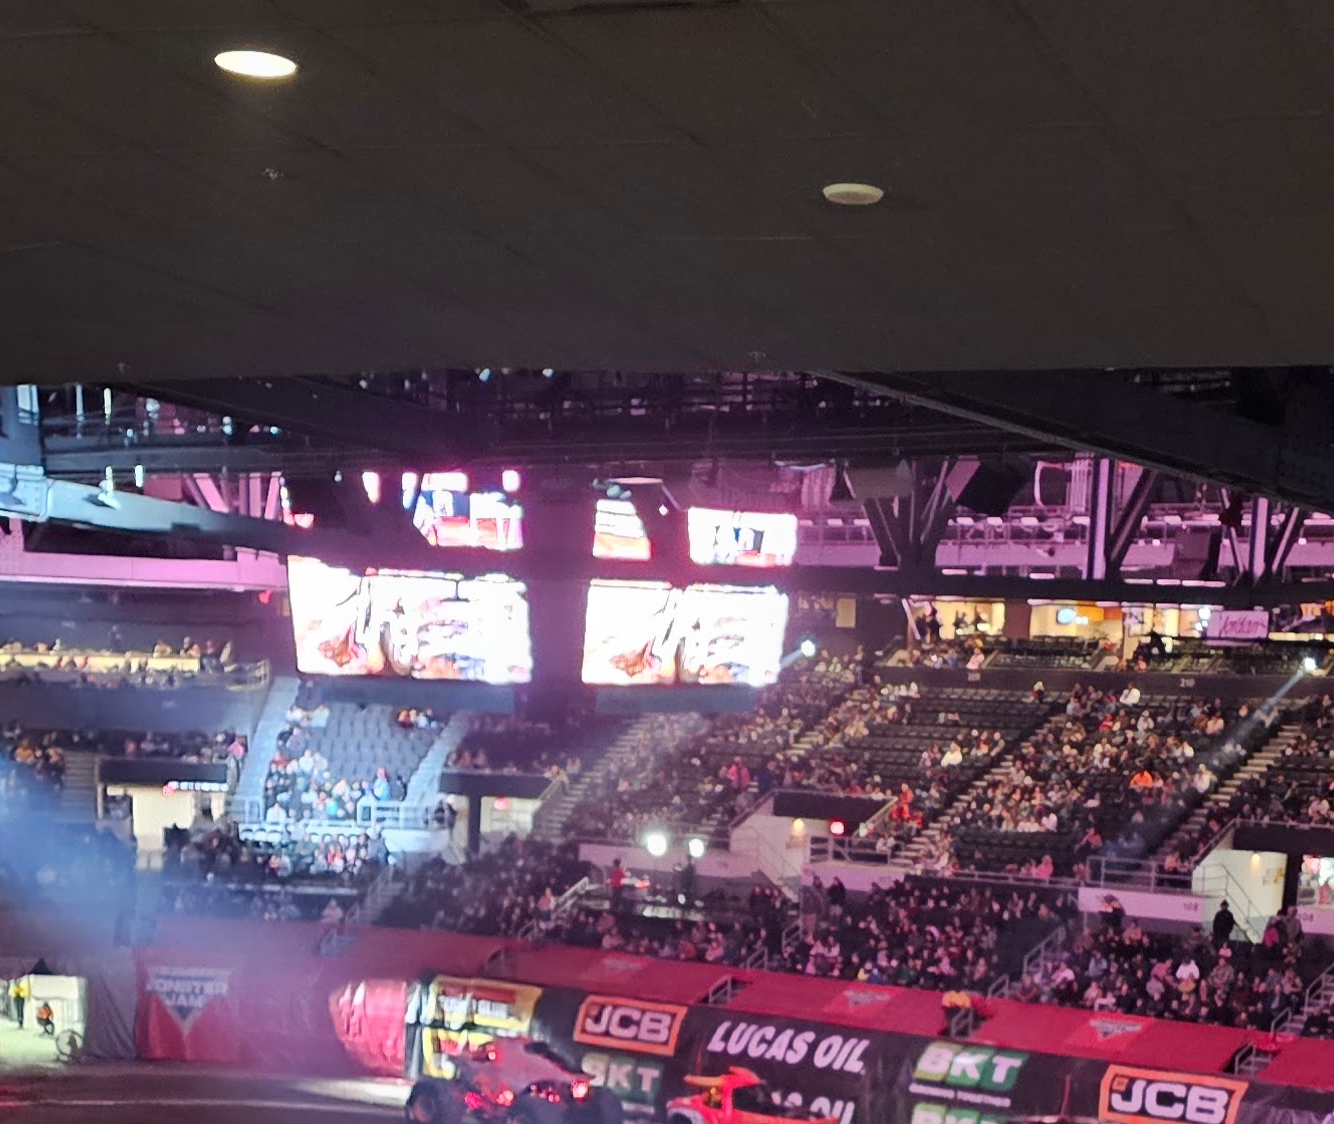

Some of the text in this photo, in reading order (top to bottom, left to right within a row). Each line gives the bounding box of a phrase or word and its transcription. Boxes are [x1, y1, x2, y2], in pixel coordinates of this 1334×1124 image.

[585, 1005, 672, 1043] JCB
[707, 1020, 871, 1074] LUCAS OIL
[917, 1047, 1023, 1084] BKT
[1111, 1079, 1229, 1124] JCB
